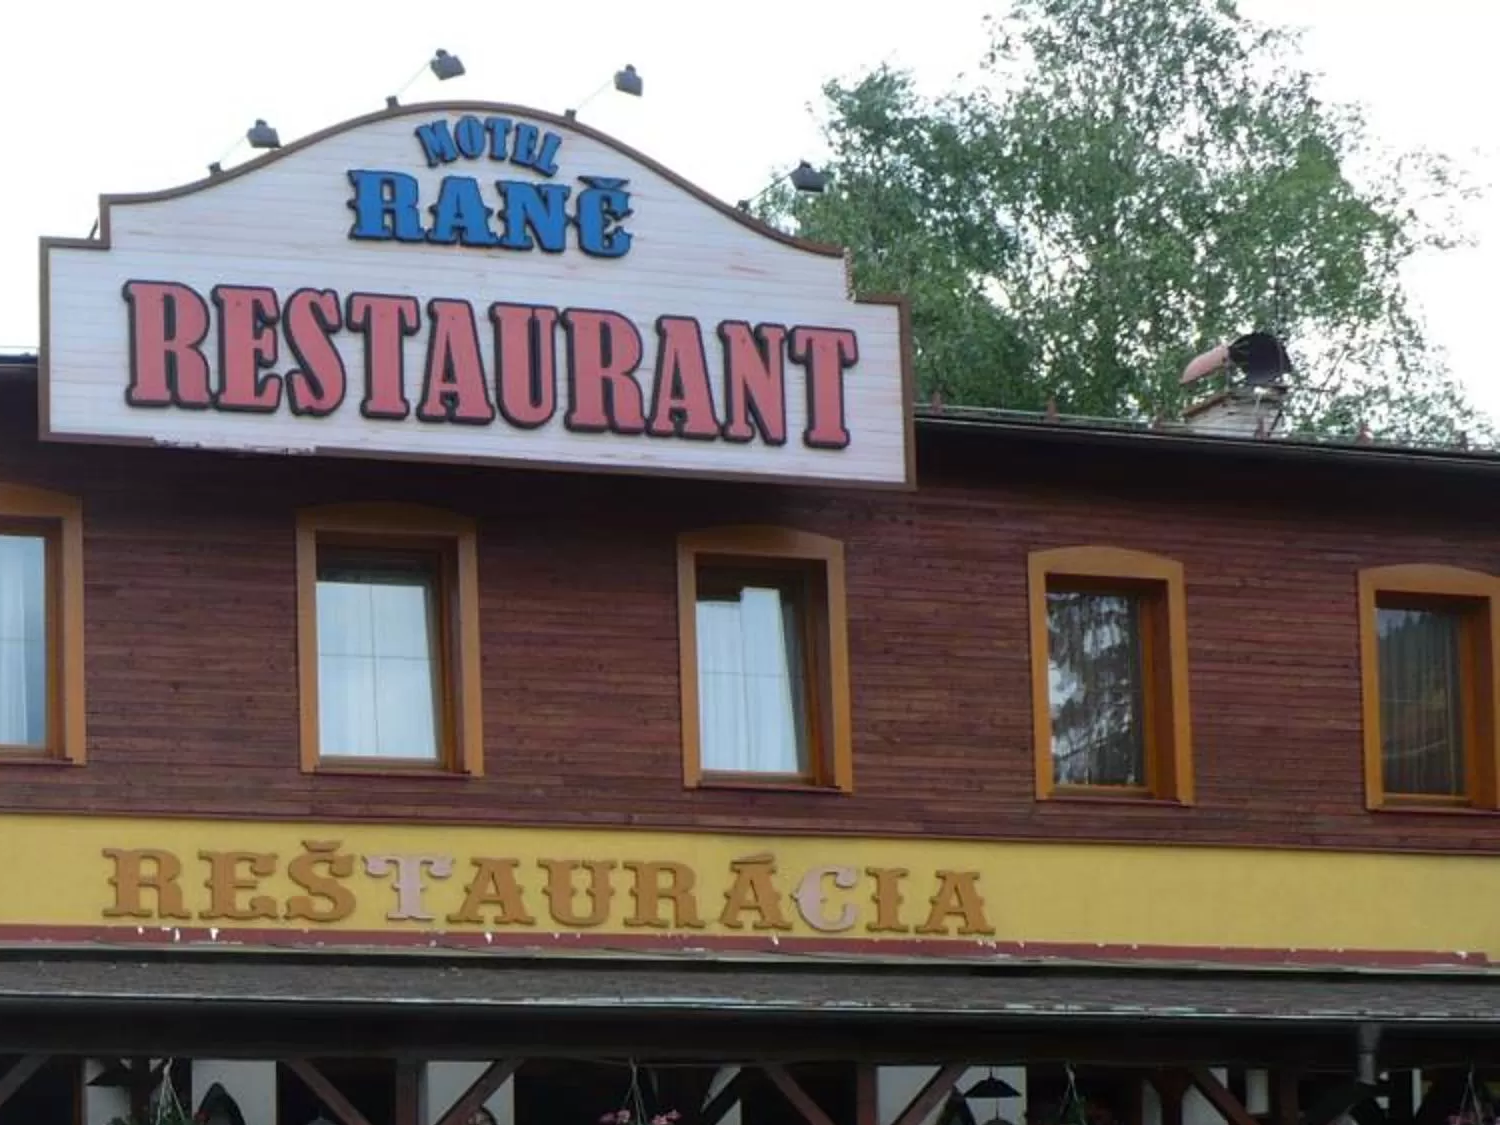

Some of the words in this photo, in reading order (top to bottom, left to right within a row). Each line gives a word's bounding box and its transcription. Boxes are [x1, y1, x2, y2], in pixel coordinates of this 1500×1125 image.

[415, 114, 562, 177] MOTEL
[346, 168, 633, 258] RANČ
[122, 279, 859, 450] RESTAURANT
[102, 839, 996, 936] REŠTAURÁCIA
